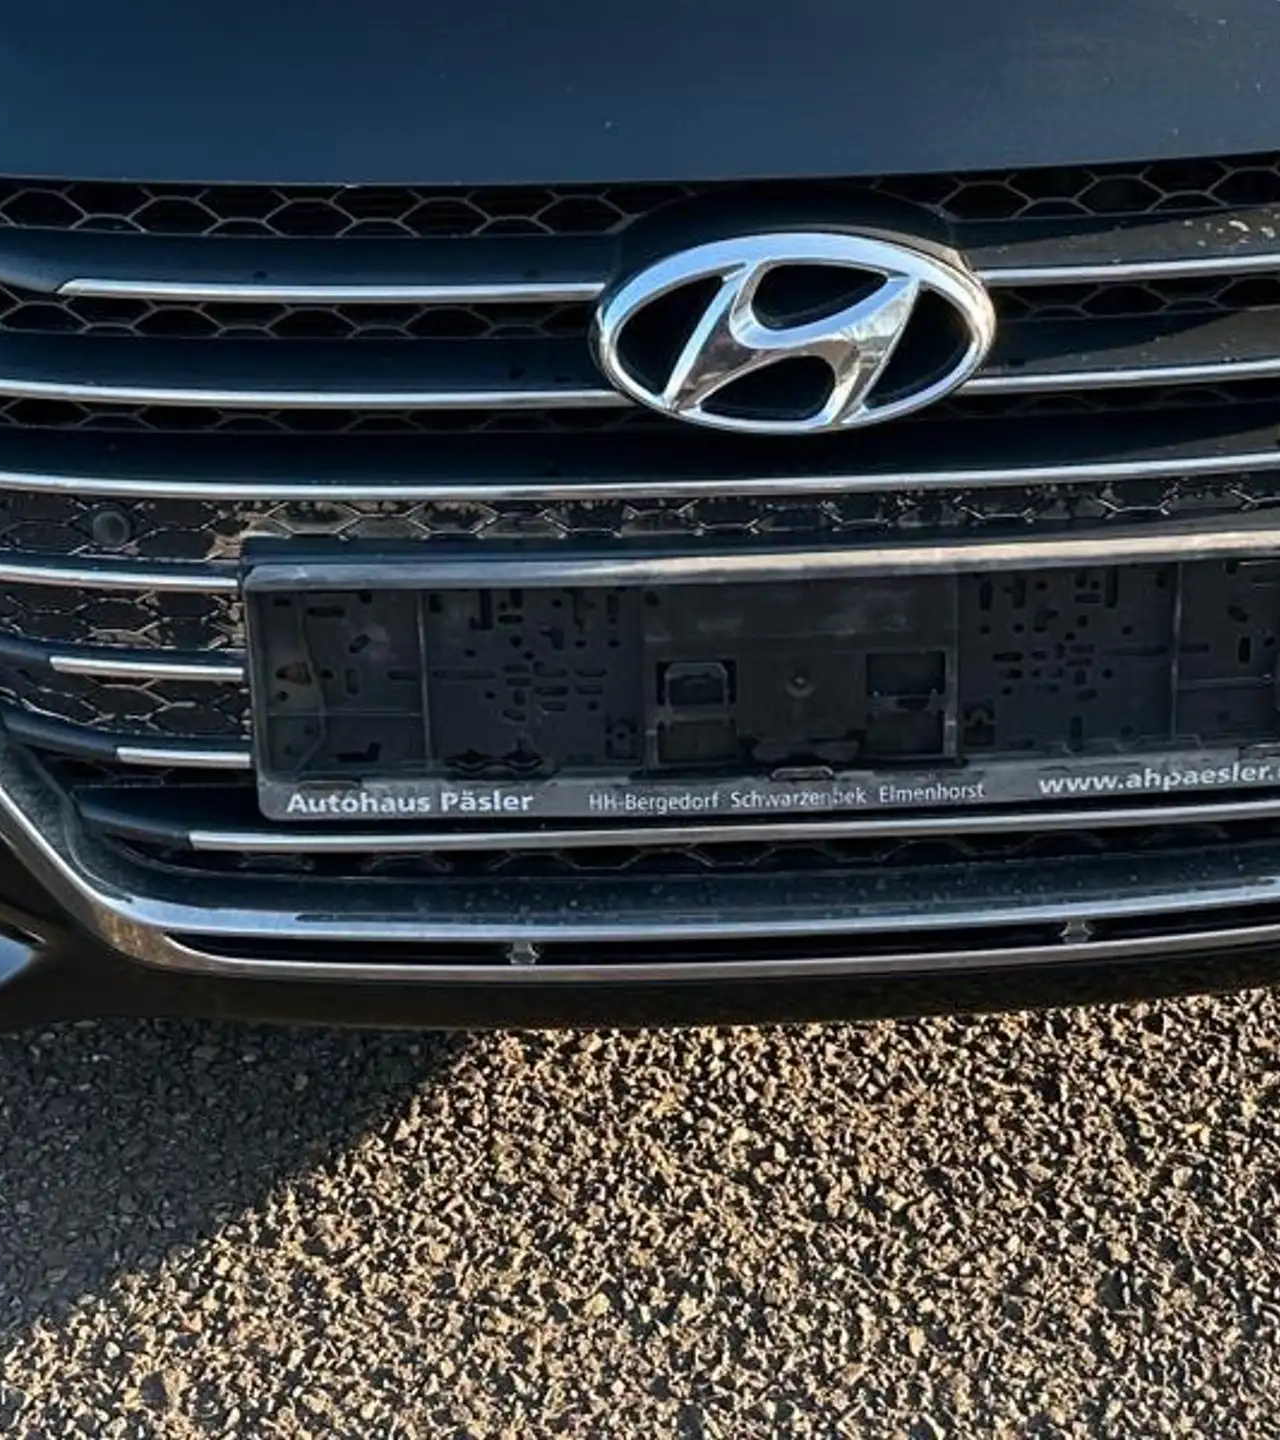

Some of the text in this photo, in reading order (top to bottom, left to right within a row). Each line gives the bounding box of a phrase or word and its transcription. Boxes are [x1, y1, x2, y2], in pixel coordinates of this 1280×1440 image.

[286, 789, 535, 813] Autohaus Päsler
[588, 790, 720, 815] HH-Bergedorf
[878, 782, 985, 804] Elmenhorst
